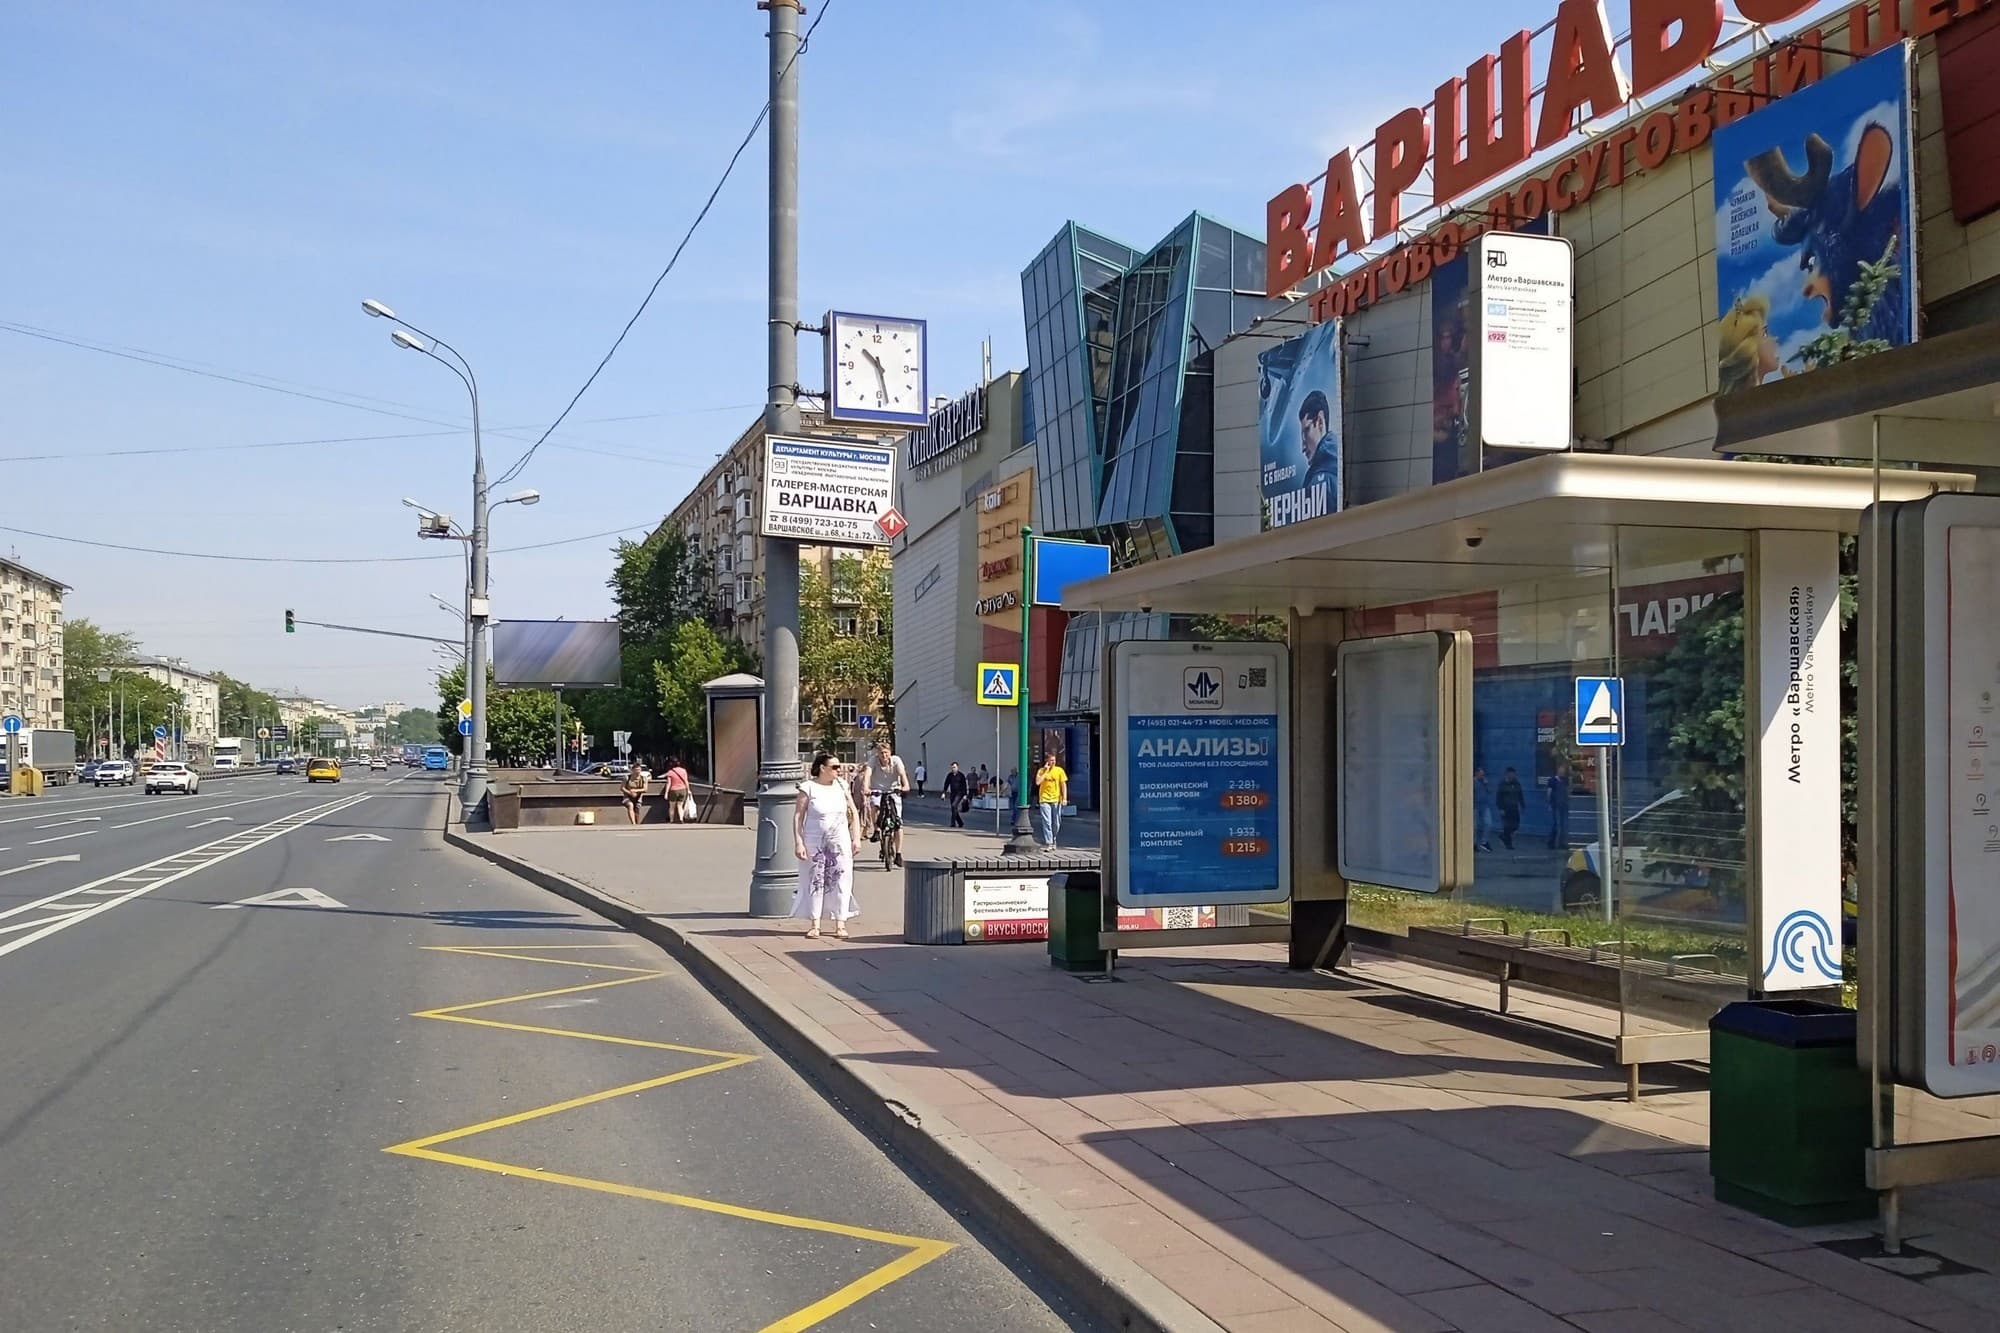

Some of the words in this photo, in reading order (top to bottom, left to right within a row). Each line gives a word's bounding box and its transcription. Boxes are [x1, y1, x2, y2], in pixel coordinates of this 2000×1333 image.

[1267, 0, 1826, 298] ВАРШАВ
[1487, 274, 1512, 283] Метро
[872, 335, 883, 345] 12
[848, 361, 855, 370] 9
[903, 365, 910, 374] 3
[876, 390, 883, 400] 6
[906, 387, 982, 470] КИНОКВАРТАЛ
[775, 446, 820, 456] ДЕПАРТАМЕНТ
[820, 449, 853, 459] КУЛЬТУРЫ
[859, 452, 887, 462] МОСКВЫ
[771, 479, 888, 498] ГАЛЕРЕЯ-МАСТЕРСКАЯ
[779, 492, 878, 515] ВАРШАВКА
[1264, 473, 1327, 528] ЧЕРНЫЙ
[768, 523, 814, 535] ВАРШАВСКОЕ
[781, 515, 788, 523] 8
[789, 516, 813, 526] (499)
[815, 518, 858, 529] 723-10-75
[1614, 590, 1733, 637] ПАРК
[1804, 586, 1814, 671] Varshavskaya
[1804, 674, 1814, 713] Metro
[1787, 722, 1803, 783] Метро
[1157, 760, 1206, 768] ЛАБОРАТОРИЯ
[1139, 781, 1208, 790] БИОХИМИЧЕСКИЙ
[1139, 829, 1204, 839] ГОСПИТАЛЬНЫЙ
[1140, 839, 1183, 847] КОМПЛЕКС
[973, 899, 1028, 907] Гастрономический
[973, 907, 1004, 915] фестиваль
[988, 922, 1018, 936] ВКУСЫ
